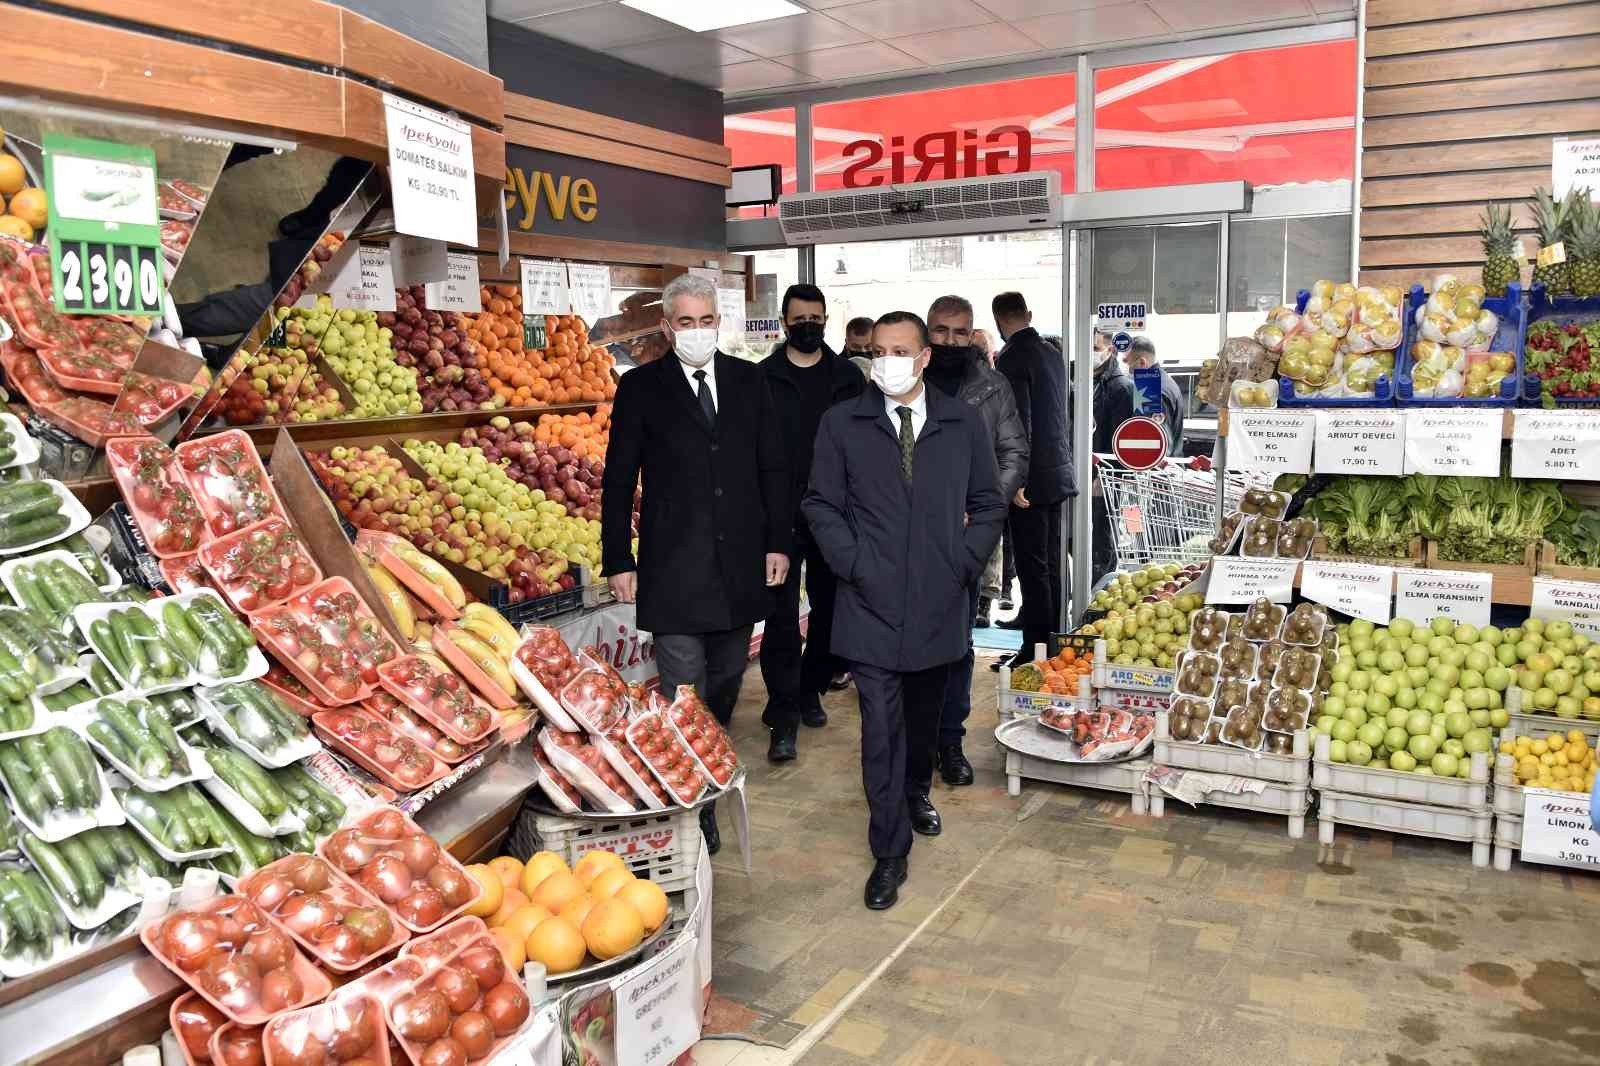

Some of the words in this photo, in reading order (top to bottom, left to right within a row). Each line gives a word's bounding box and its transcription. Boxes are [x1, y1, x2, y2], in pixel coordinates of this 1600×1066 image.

[395, 147, 436, 170] DOMATES
[1098, 304, 1146, 318] SETCARD
[745, 320, 779, 331] SETCARD
[1572, 837, 1589, 846] KG
[1586, 855, 1600, 864] TL
